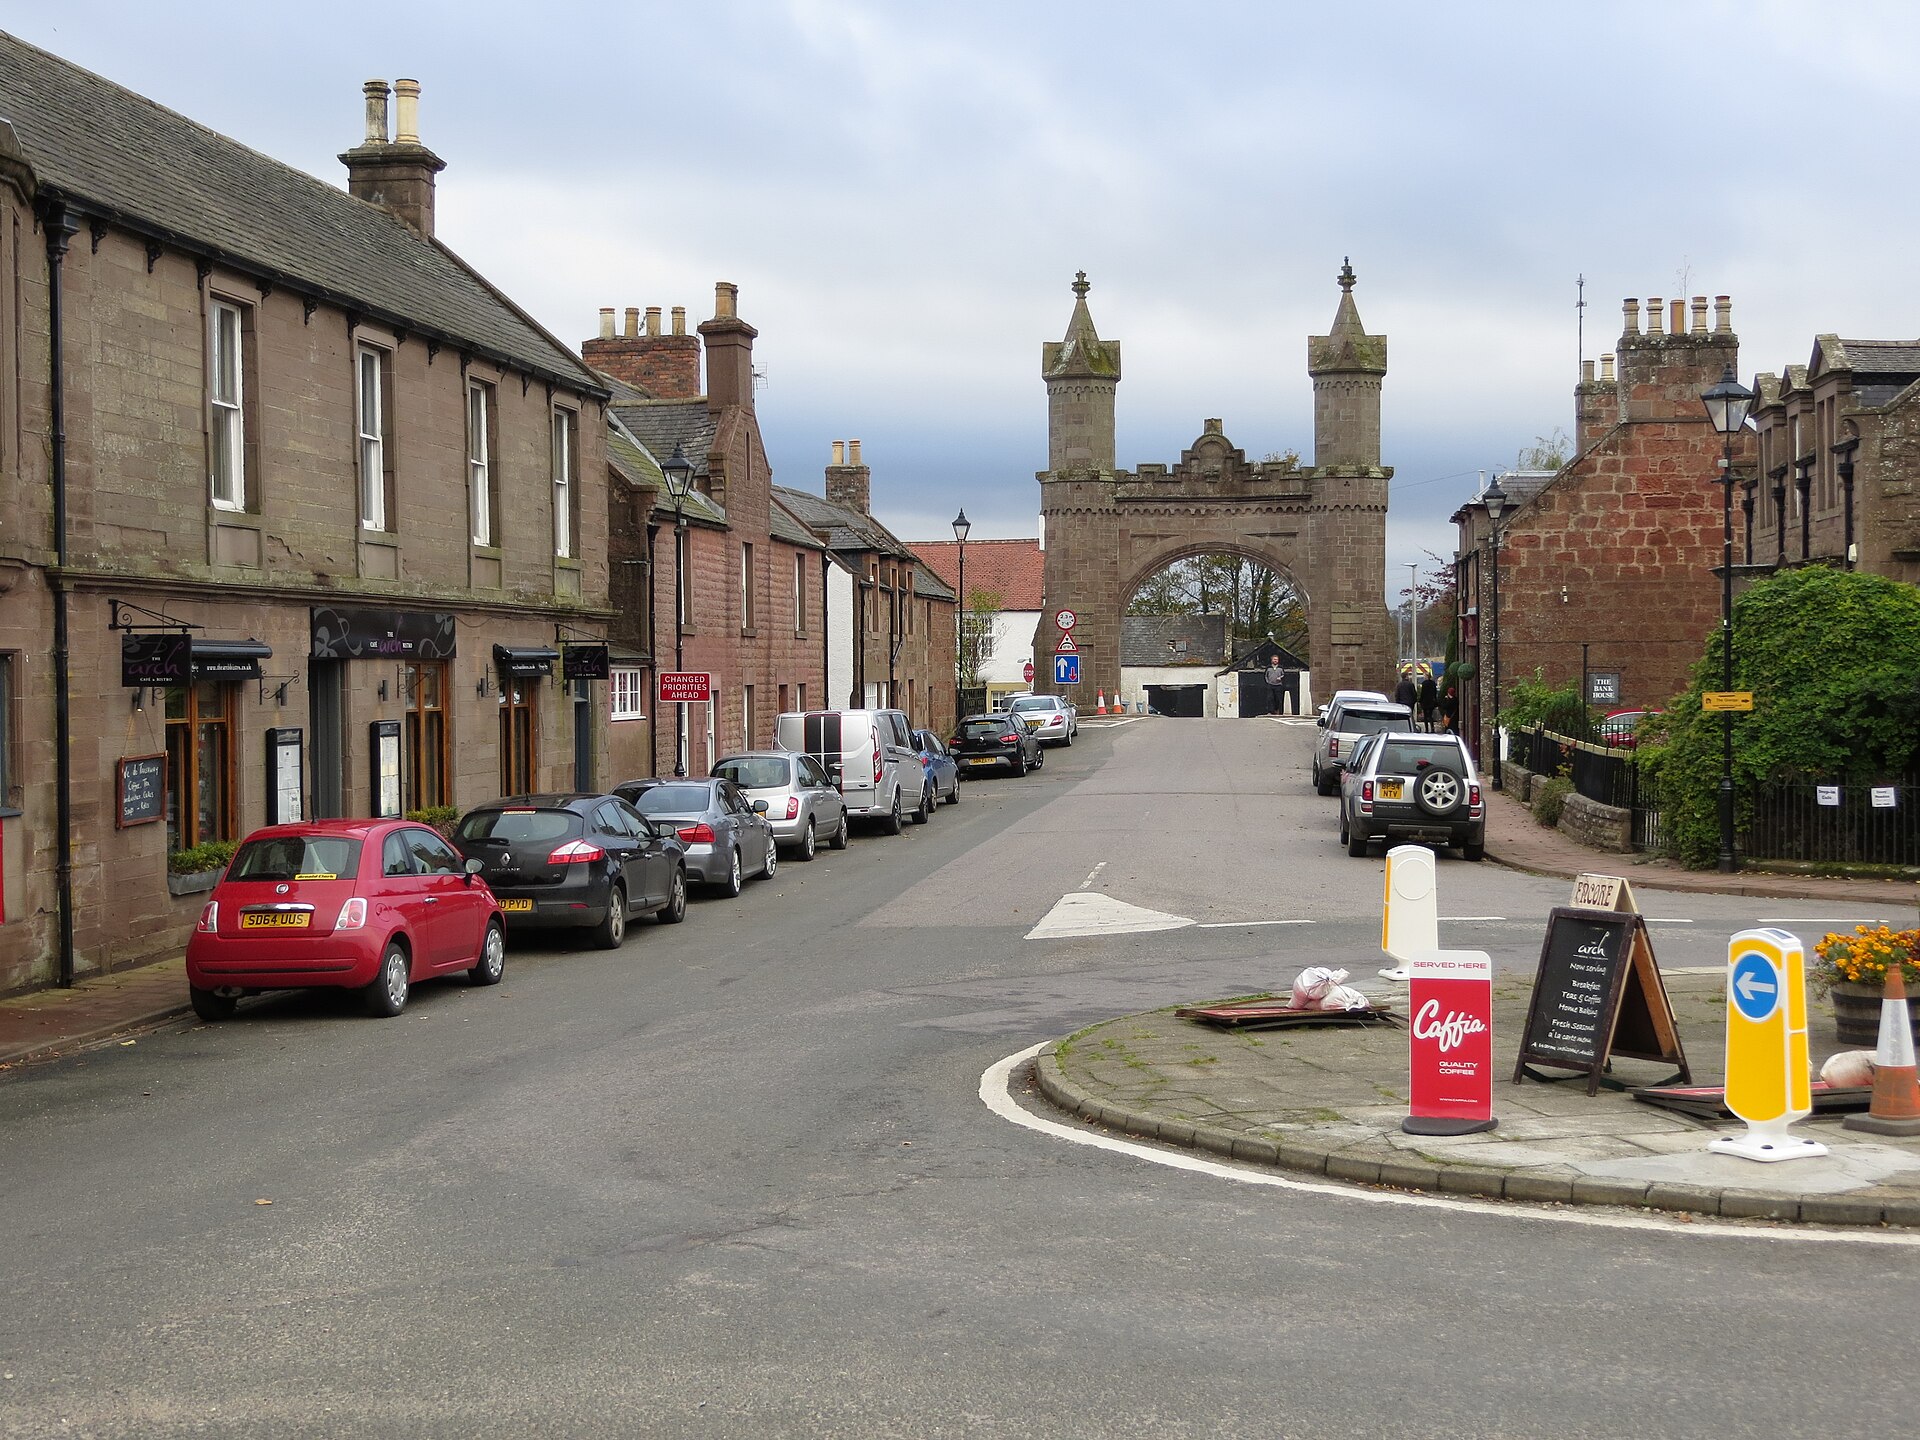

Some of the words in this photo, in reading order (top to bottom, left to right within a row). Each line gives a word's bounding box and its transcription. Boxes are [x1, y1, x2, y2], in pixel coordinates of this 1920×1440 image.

[379, 616, 404, 654] arch
[128, 641, 184, 676] arch
[567, 650, 604, 673] arch
[1023, 669, 1035, 677] STOP
[664, 675, 705, 683] CHANGED
[662, 683, 707, 691] PRIORITIES
[671, 691, 699, 699] AHEAD
[1381, 782, 1400, 790] BP54
[508, 900, 528, 909] PYD
[248, 913, 278, 926] SD64
[280, 912, 304, 925] UUS
[1577, 930, 1610, 957] arch
[1413, 961, 1456, 969] SERVED
[1457, 962, 1487, 970] HERE
[1569, 962, 1585, 970] Now
[1585, 963, 1606, 976] serving
[1571, 979, 1601, 991] Breakfast
[1561, 991, 1577, 1000] Teas
[1558, 1003, 1578, 1013] Home
[1578, 1006, 1598, 1018] Baking
[1413, 999, 1486, 1053] Caffia
[1551, 1018, 1570, 1029] Fresh
[1570, 1022, 1595, 1031] Seasonal
[1561, 1033, 1577, 1042] carte
[1577, 1036, 1592, 1044] menu
[1439, 1068, 1475, 1076] COFFEE
